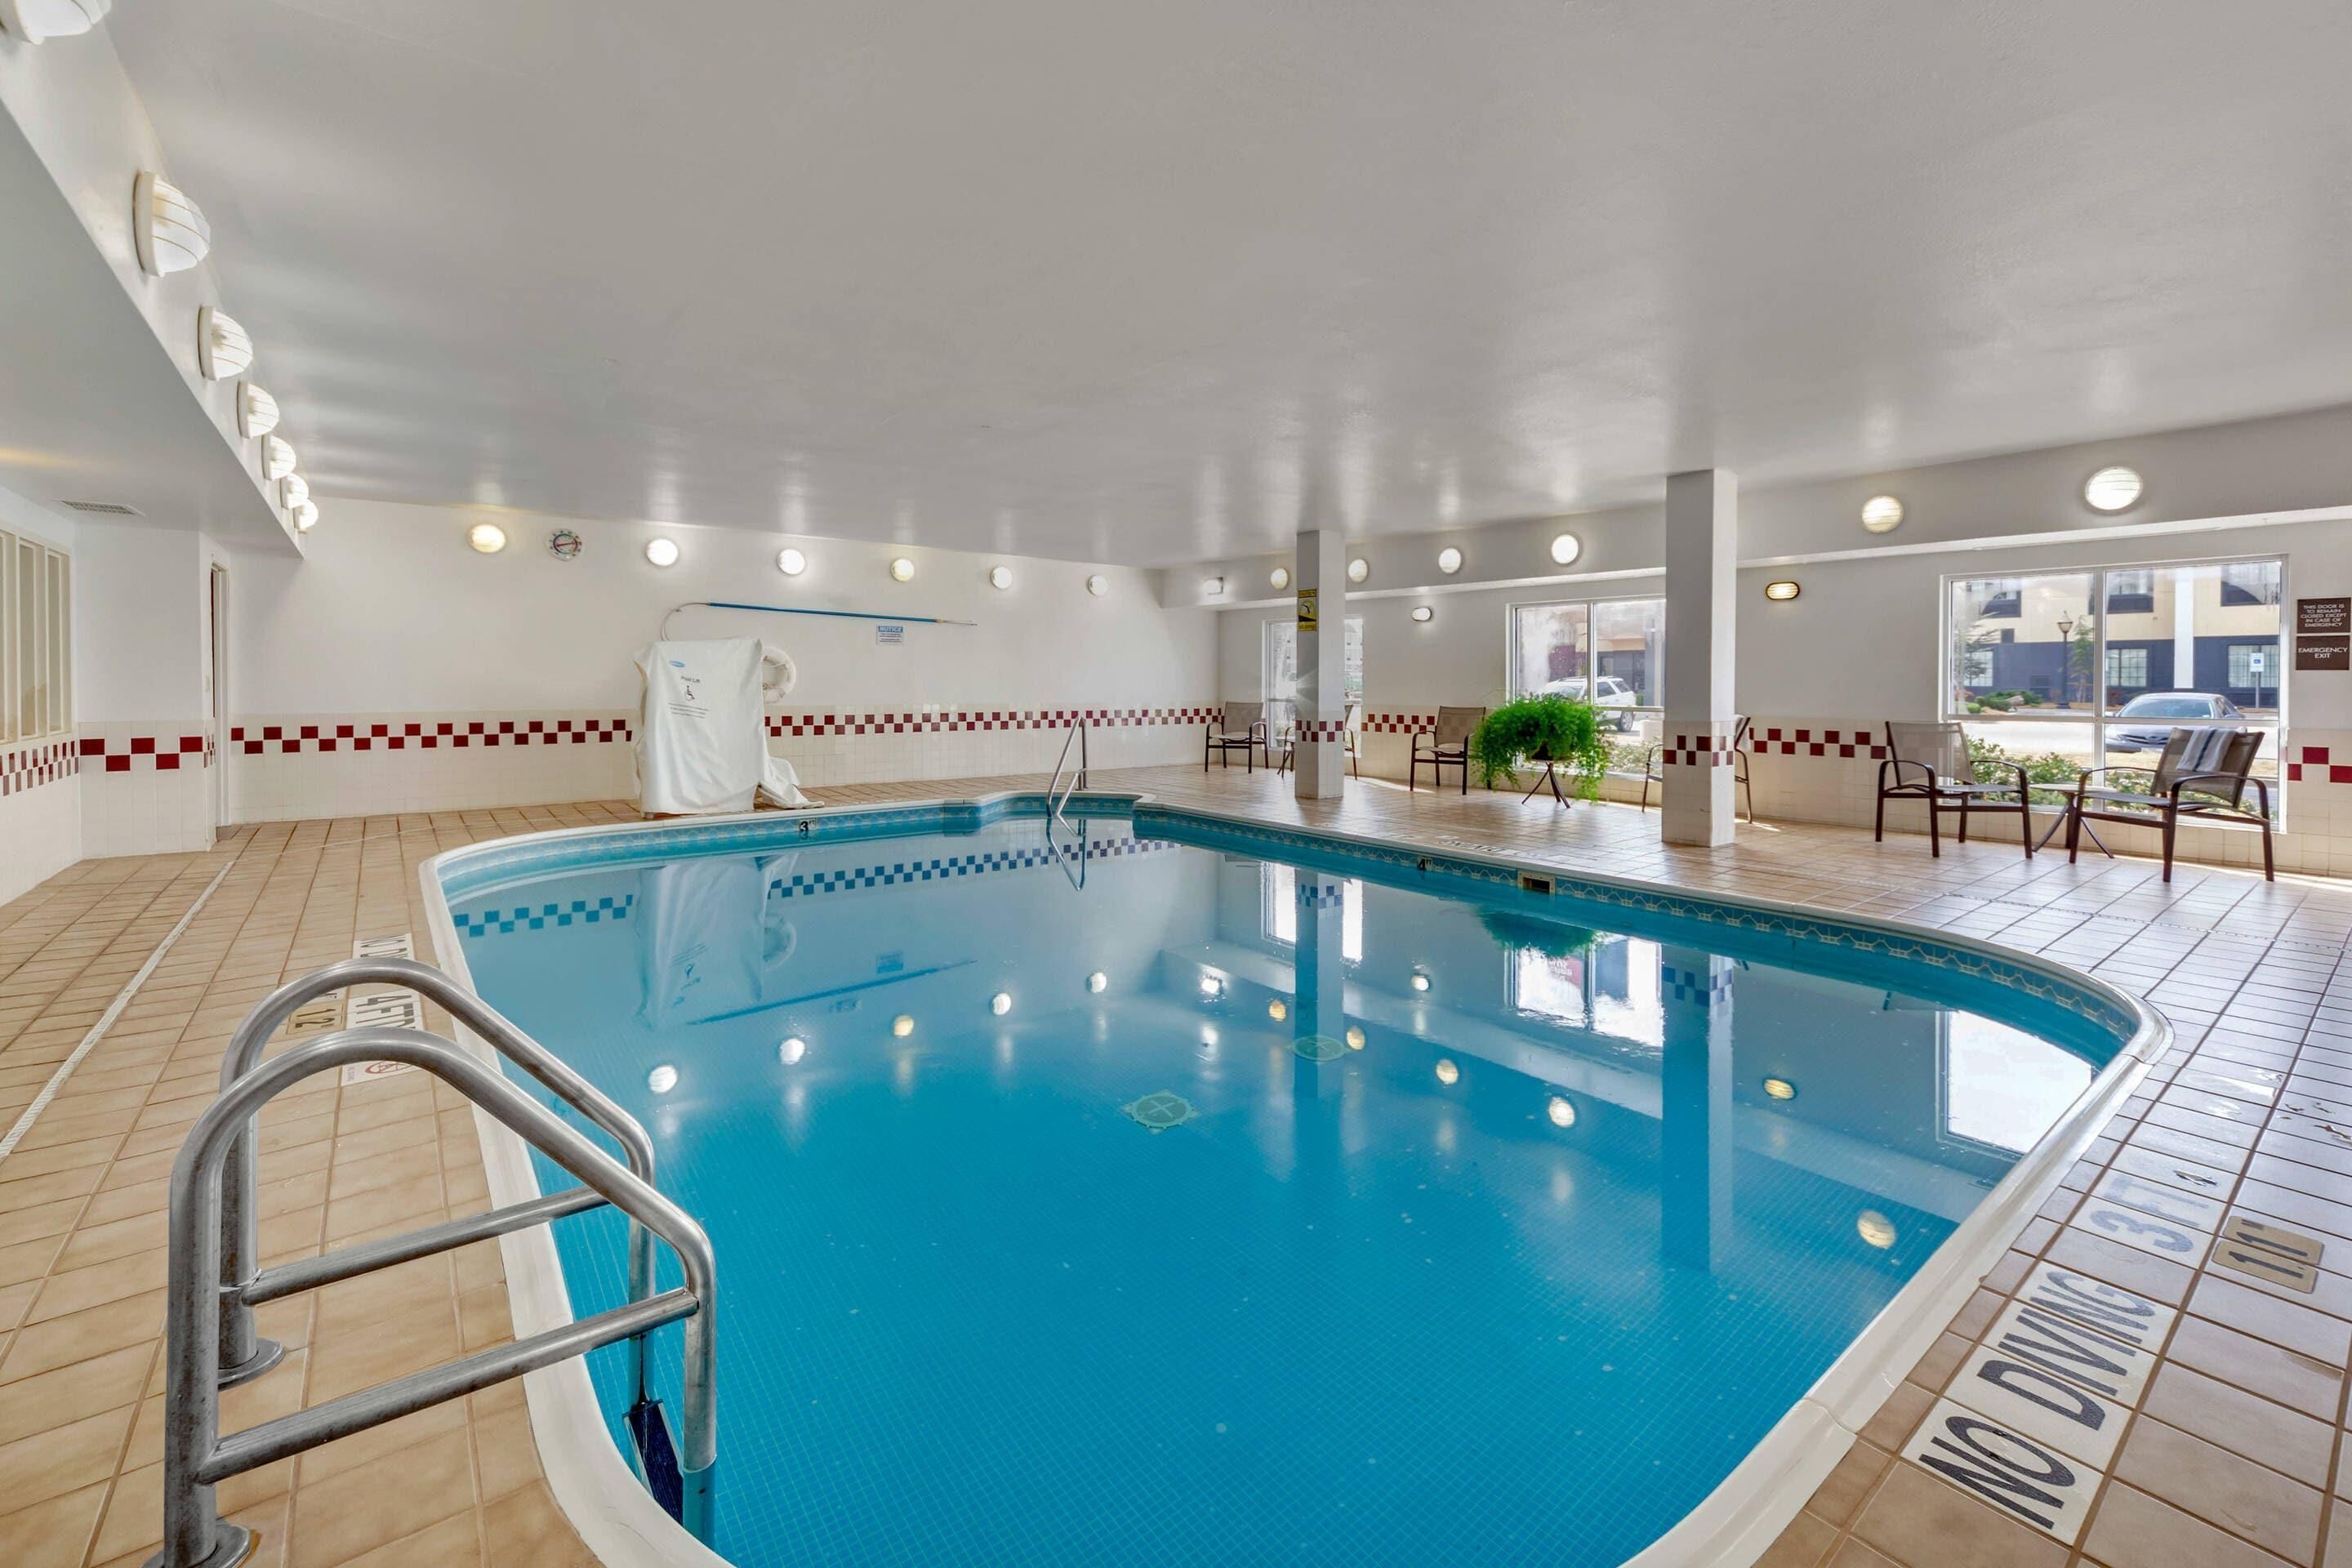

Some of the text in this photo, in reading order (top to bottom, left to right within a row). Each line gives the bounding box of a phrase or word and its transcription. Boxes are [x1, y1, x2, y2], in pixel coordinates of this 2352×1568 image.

[800, 820, 808, 831] 3
[1918, 1270, 2157, 1530] NO DIVING
